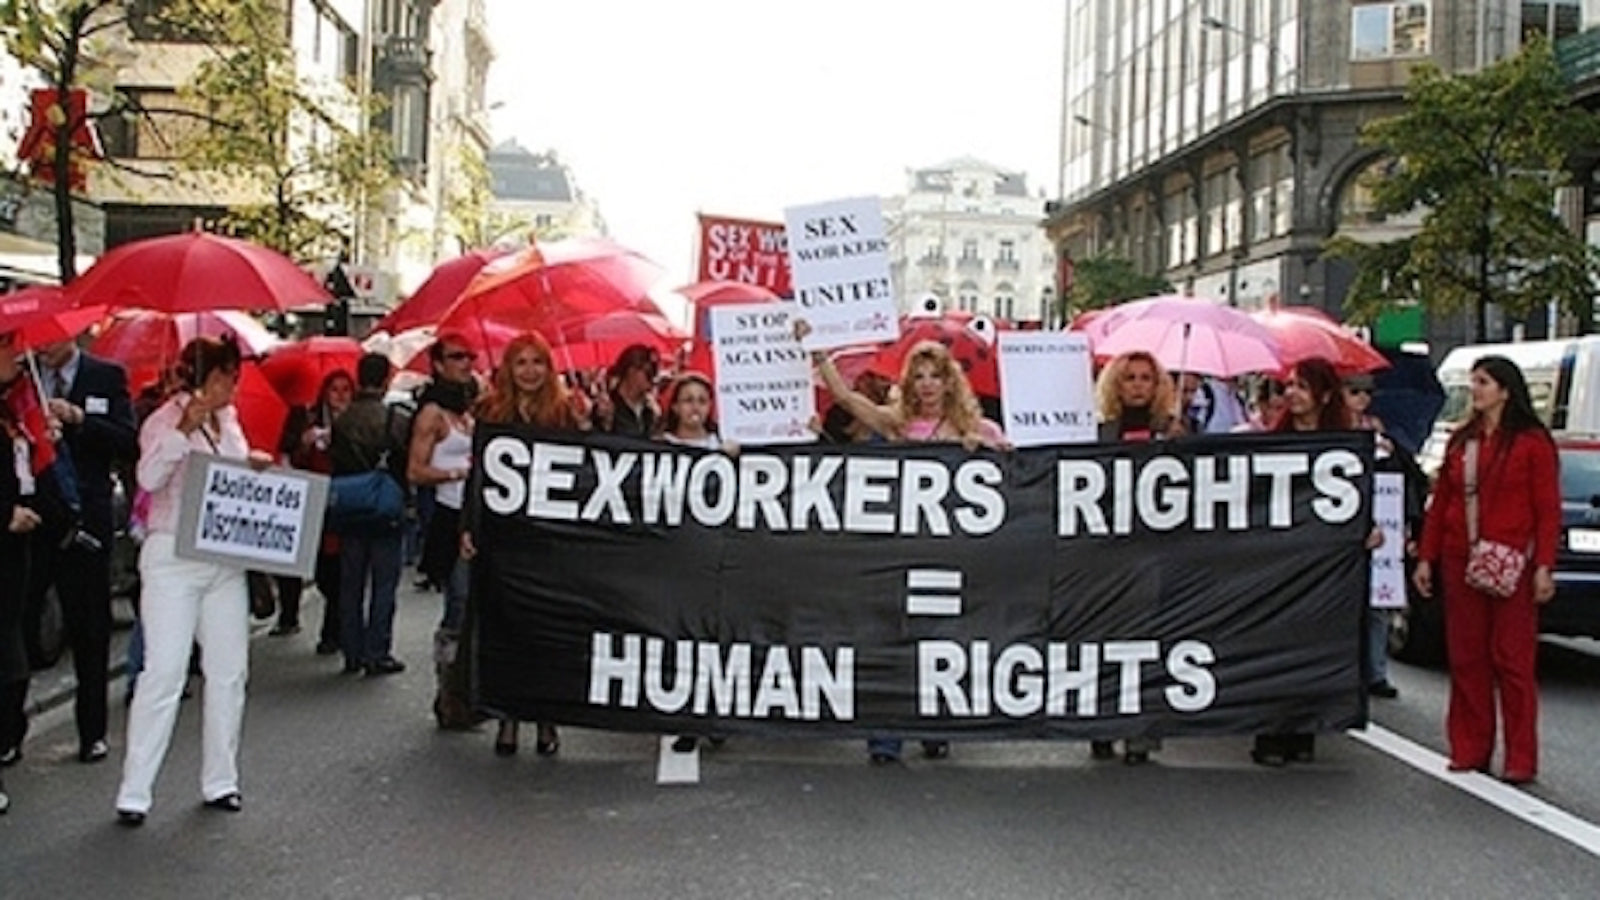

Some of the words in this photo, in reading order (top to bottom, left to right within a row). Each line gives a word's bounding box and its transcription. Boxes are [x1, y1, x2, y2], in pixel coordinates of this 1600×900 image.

[708, 223, 752, 260] SEX
[804, 214, 857, 240] SEX
[798, 239, 889, 262] WORKERS
[801, 277, 890, 309] UNITE!
[735, 312, 789, 331] STOP
[208, 470, 273, 502] Abolition
[275, 482, 301, 510] des
[482, 436, 1006, 536] SEXWORKERS
[1057, 449, 1365, 536] RIGHTS
[588, 632, 855, 721] HUMAN
[918, 639, 1217, 718] RIGHTS
